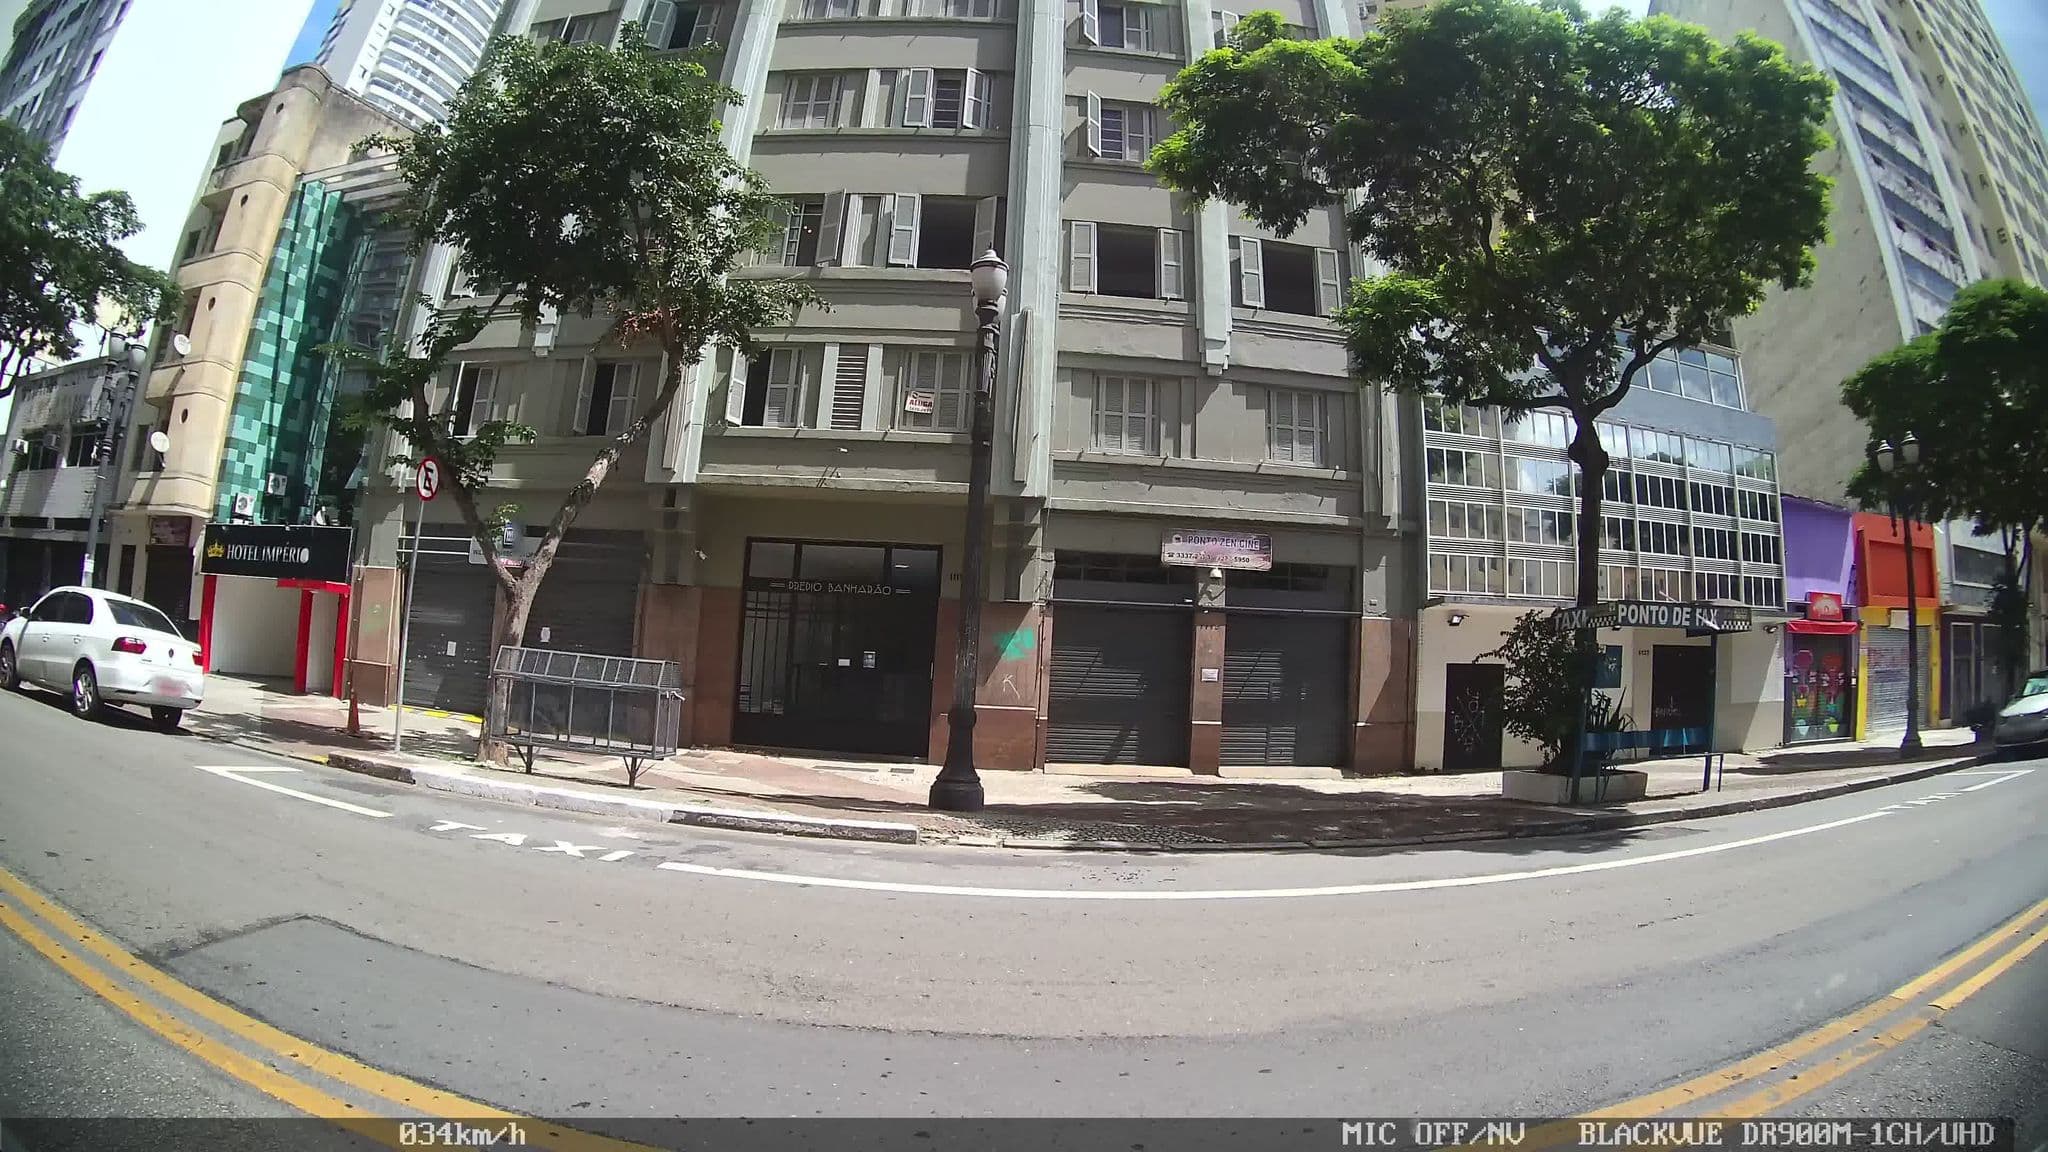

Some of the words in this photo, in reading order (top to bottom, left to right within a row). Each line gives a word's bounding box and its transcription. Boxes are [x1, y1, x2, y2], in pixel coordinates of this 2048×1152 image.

[909, 399, 933, 408] ALUGA
[227, 544, 259, 561] HOTEL
[261, 541, 310, 564] IMPÉRIO
[1188, 535, 1217, 545] PONTO
[1220, 538, 1237, 547] ZEN
[1240, 539, 1260, 549] CINE
[1618, 604, 1669, 625] PONTO
[1673, 606, 1690, 626] DE
[429, 819, 635, 862] TAXI
